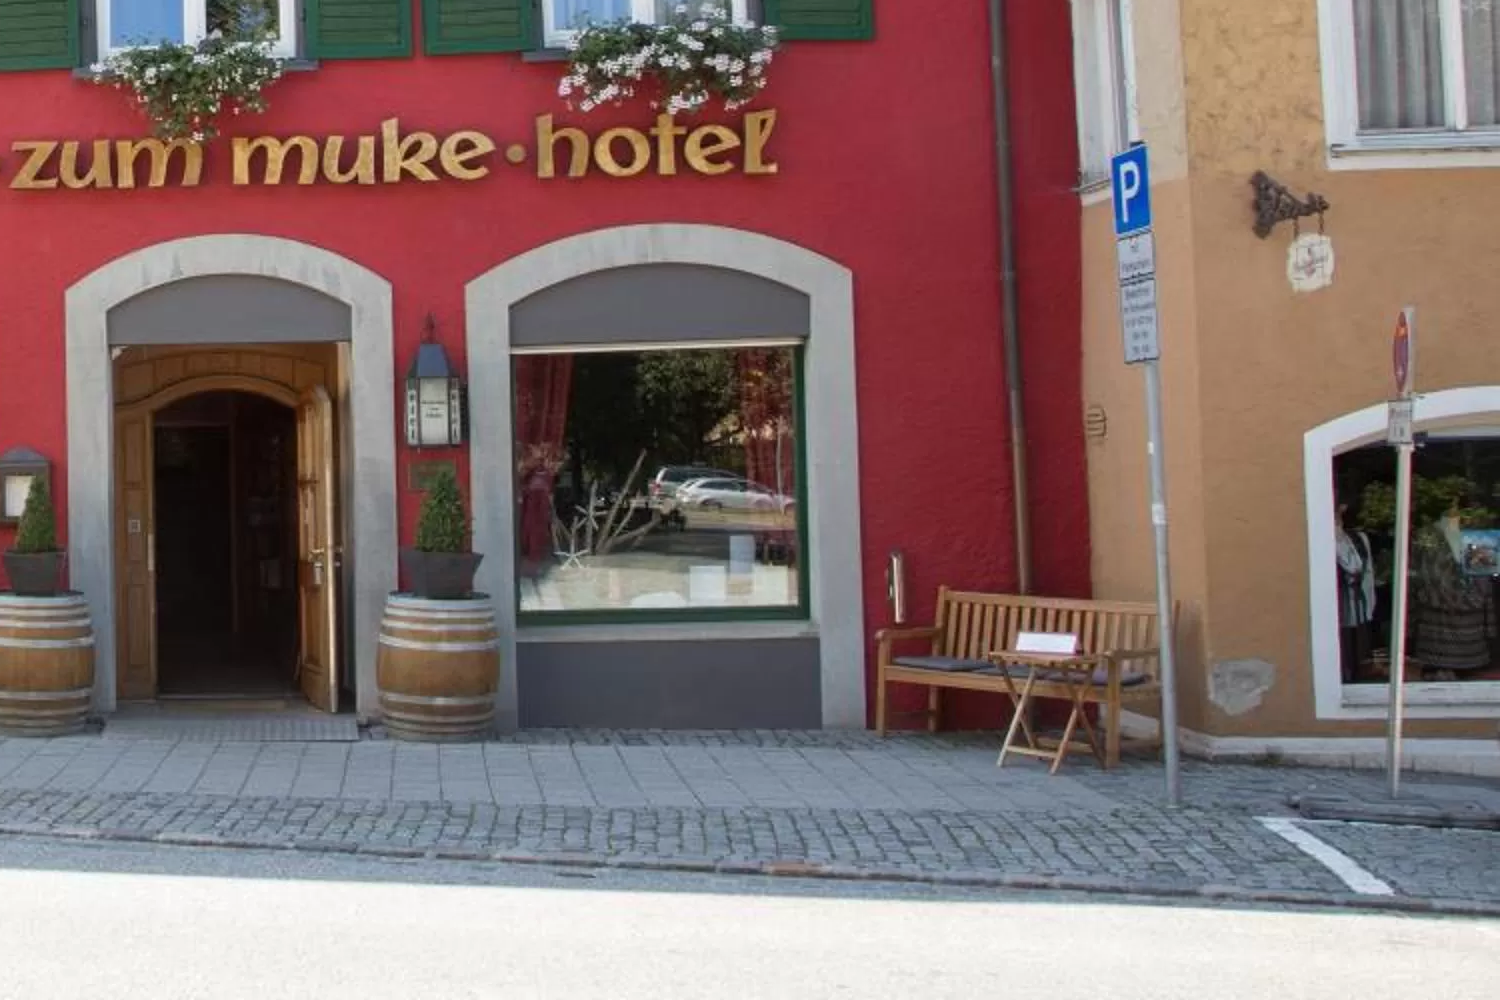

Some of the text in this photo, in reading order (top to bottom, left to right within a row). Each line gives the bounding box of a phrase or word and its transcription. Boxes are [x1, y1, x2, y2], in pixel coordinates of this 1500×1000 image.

[10, 137, 203, 188] zum
[231, 117, 496, 185] muke
[535, 108, 777, 178] hotel
[1119, 160, 1140, 223] P
